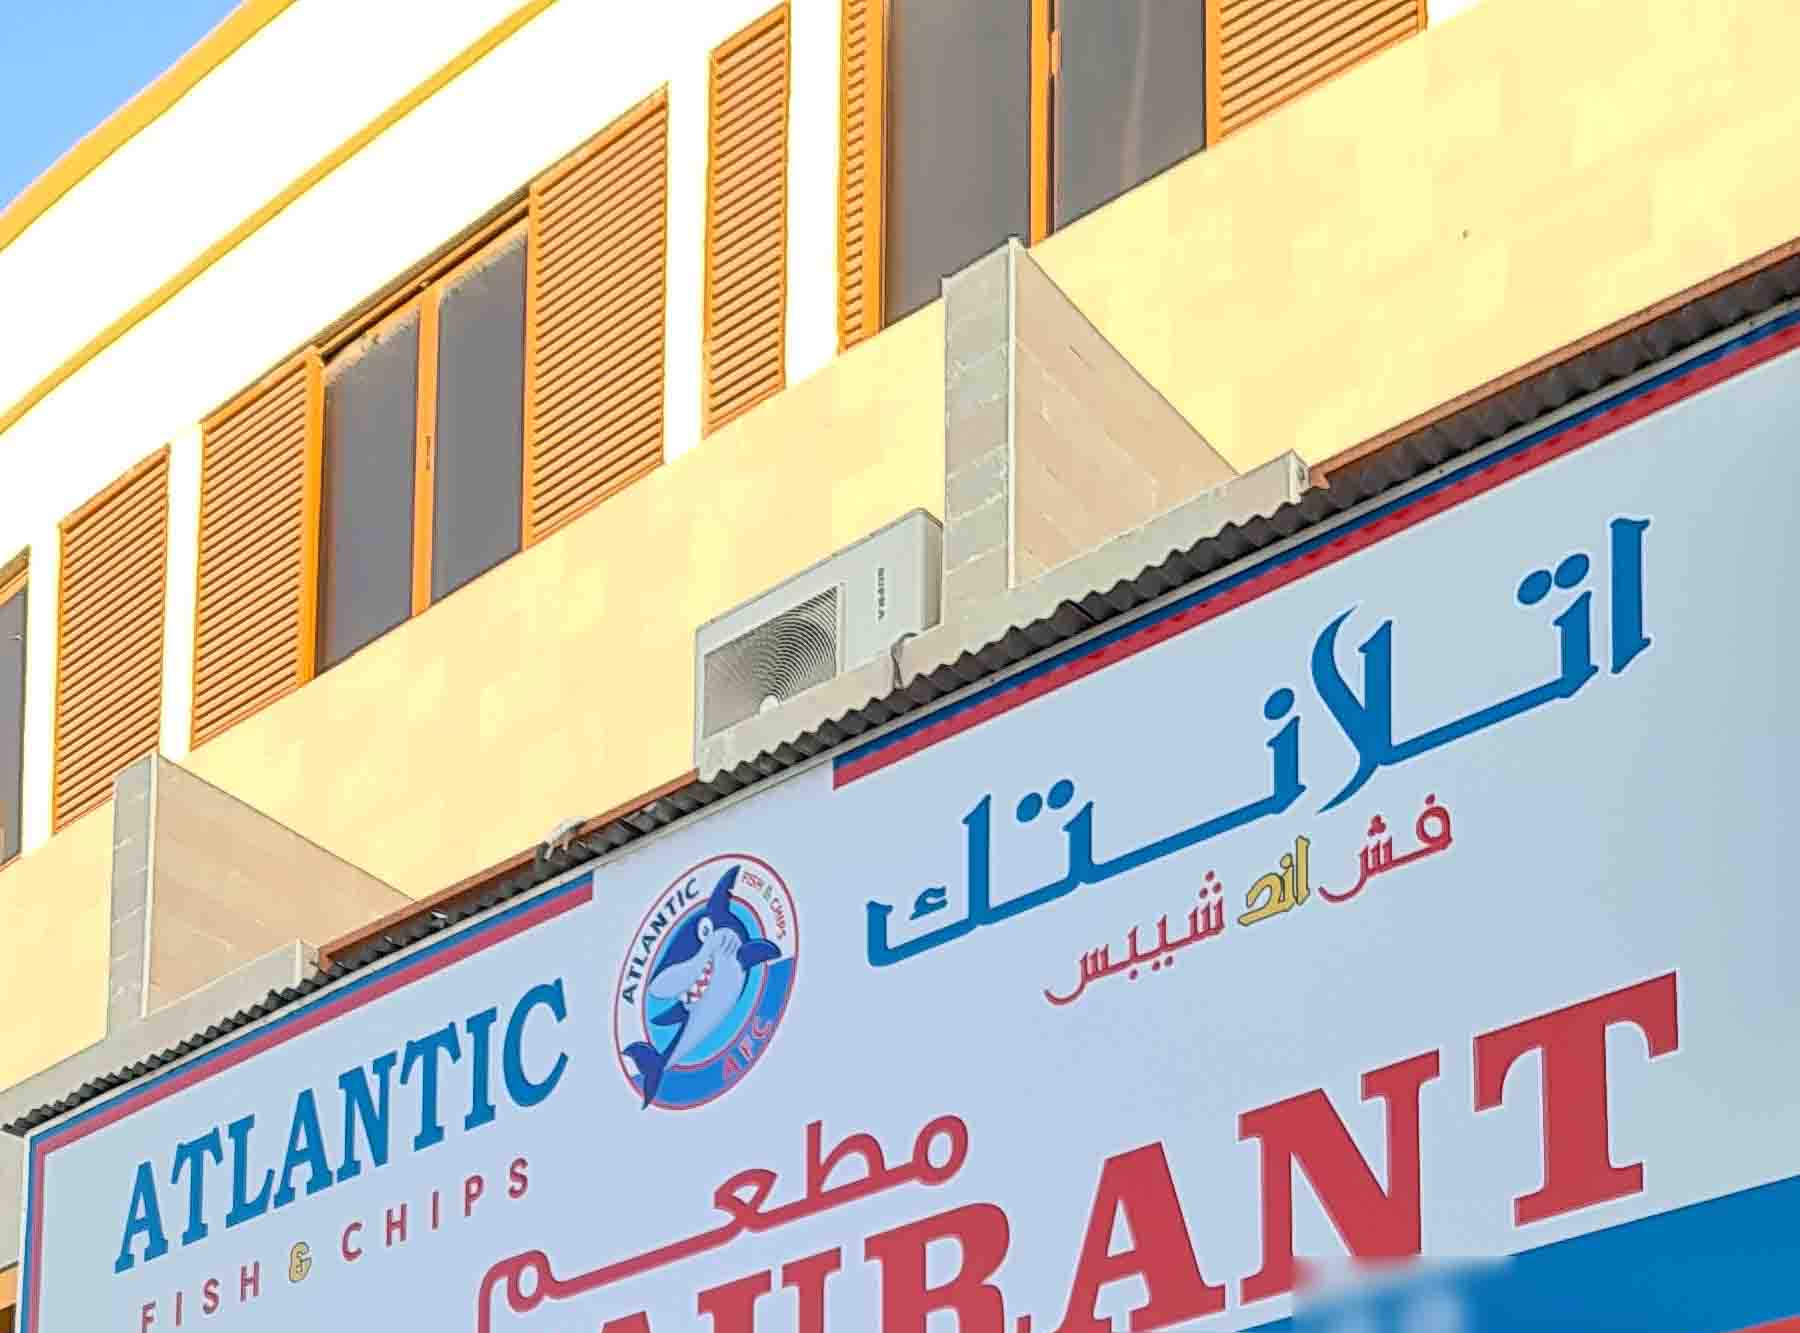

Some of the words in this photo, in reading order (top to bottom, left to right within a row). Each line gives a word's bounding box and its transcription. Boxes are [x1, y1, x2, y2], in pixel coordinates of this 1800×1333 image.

[866, 517, 1652, 969] اتلانتك
[1237, 835, 1311, 926] اند
[1318, 793, 1453, 903] فش
[621, 877, 701, 1004] ATLANTIC
[1043, 869, 1224, 1006] شيبس
[114, 978, 568, 1274] ATLANTIC
[341, 1157, 529, 1262] CHIPS
